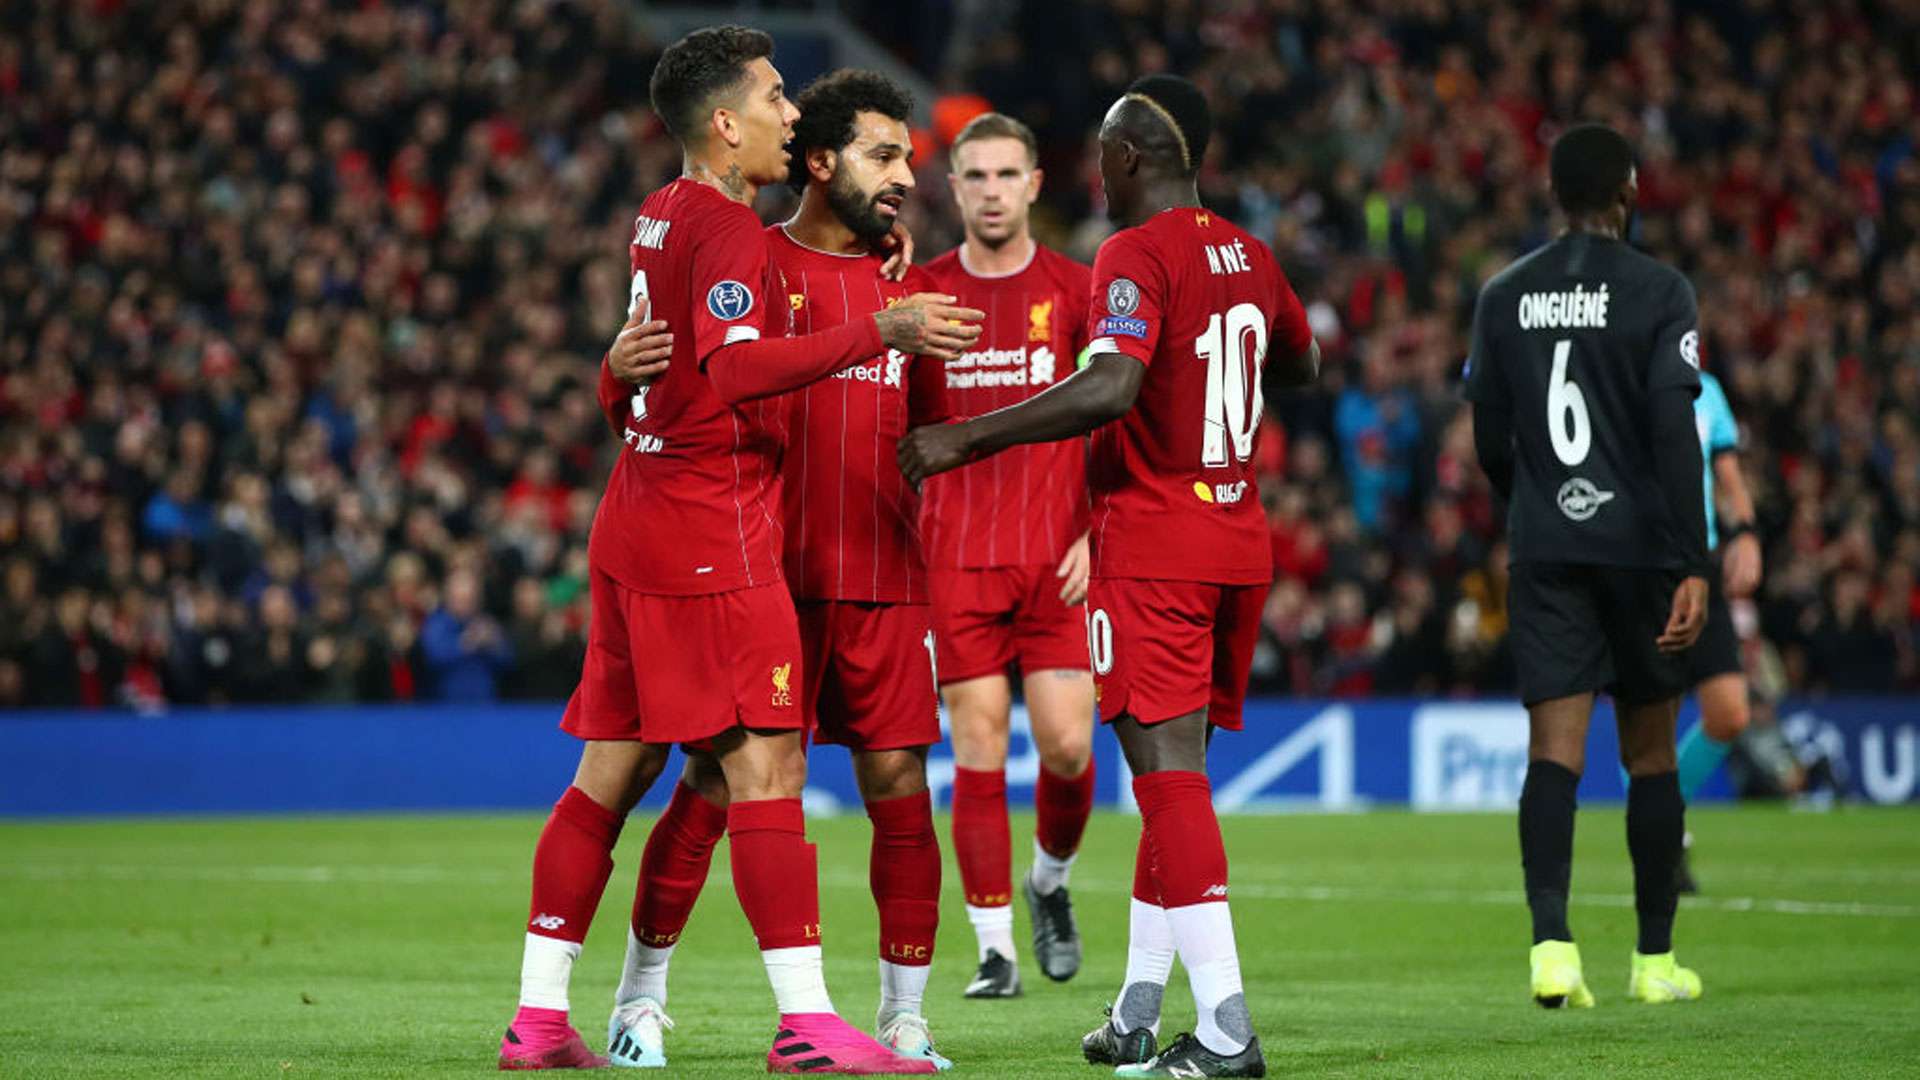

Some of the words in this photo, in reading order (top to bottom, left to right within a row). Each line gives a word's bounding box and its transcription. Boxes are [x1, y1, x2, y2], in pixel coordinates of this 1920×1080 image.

[1204, 237, 1251, 275] MNÉ
[1518, 282, 1610, 330] ONGUÉNÉ
[1194, 303, 1268, 468] 10
[1547, 339, 1592, 467] 6
